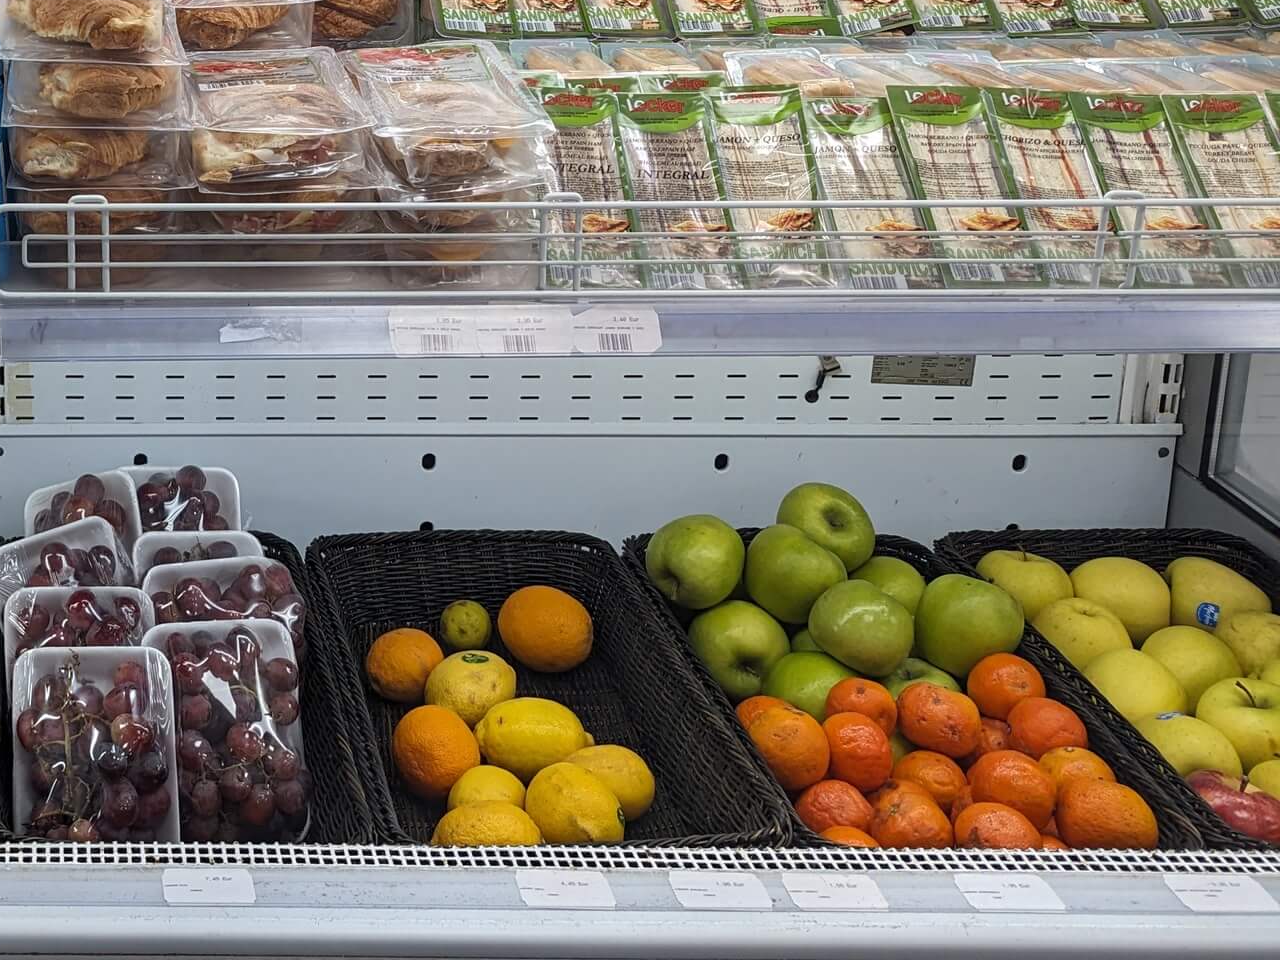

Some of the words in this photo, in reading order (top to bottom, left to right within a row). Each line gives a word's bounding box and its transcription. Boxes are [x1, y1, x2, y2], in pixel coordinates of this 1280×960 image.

[442, 7, 512, 25] SANDWICH
[514, 7, 581, 23] SANDWICH
[586, 5, 655, 20] SANDWICH
[676, 11, 750, 25] SANDWICH
[840, 4, 908, 26] ANDWICH
[763, 132, 801, 144] QUESO
[554, 162, 615, 174] NTEGRAL
[637, 169, 710, 181] INTEGRAL
